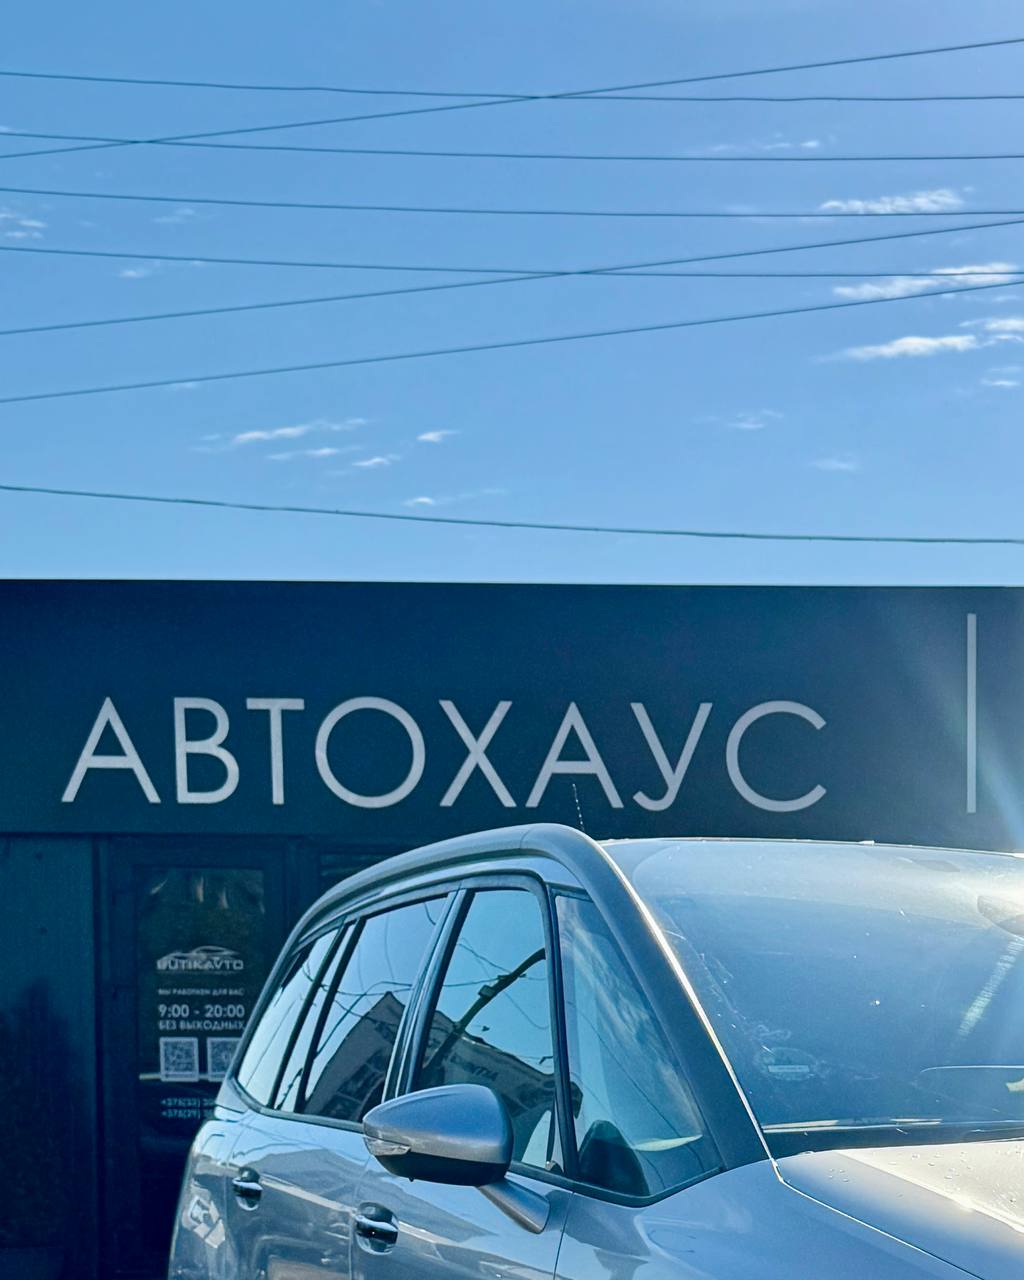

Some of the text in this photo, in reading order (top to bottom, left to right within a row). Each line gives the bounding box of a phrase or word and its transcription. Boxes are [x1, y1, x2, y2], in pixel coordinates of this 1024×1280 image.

[61, 696, 827, 813] АВТОХАУС
[156, 959, 244, 971] BUTIKAVTO
[158, 1004, 190, 1018] 9:00
[204, 1004, 245, 1018] 20:00
[158, 1019, 246, 1031] БЕЗ ВЫХОДНЫХ
